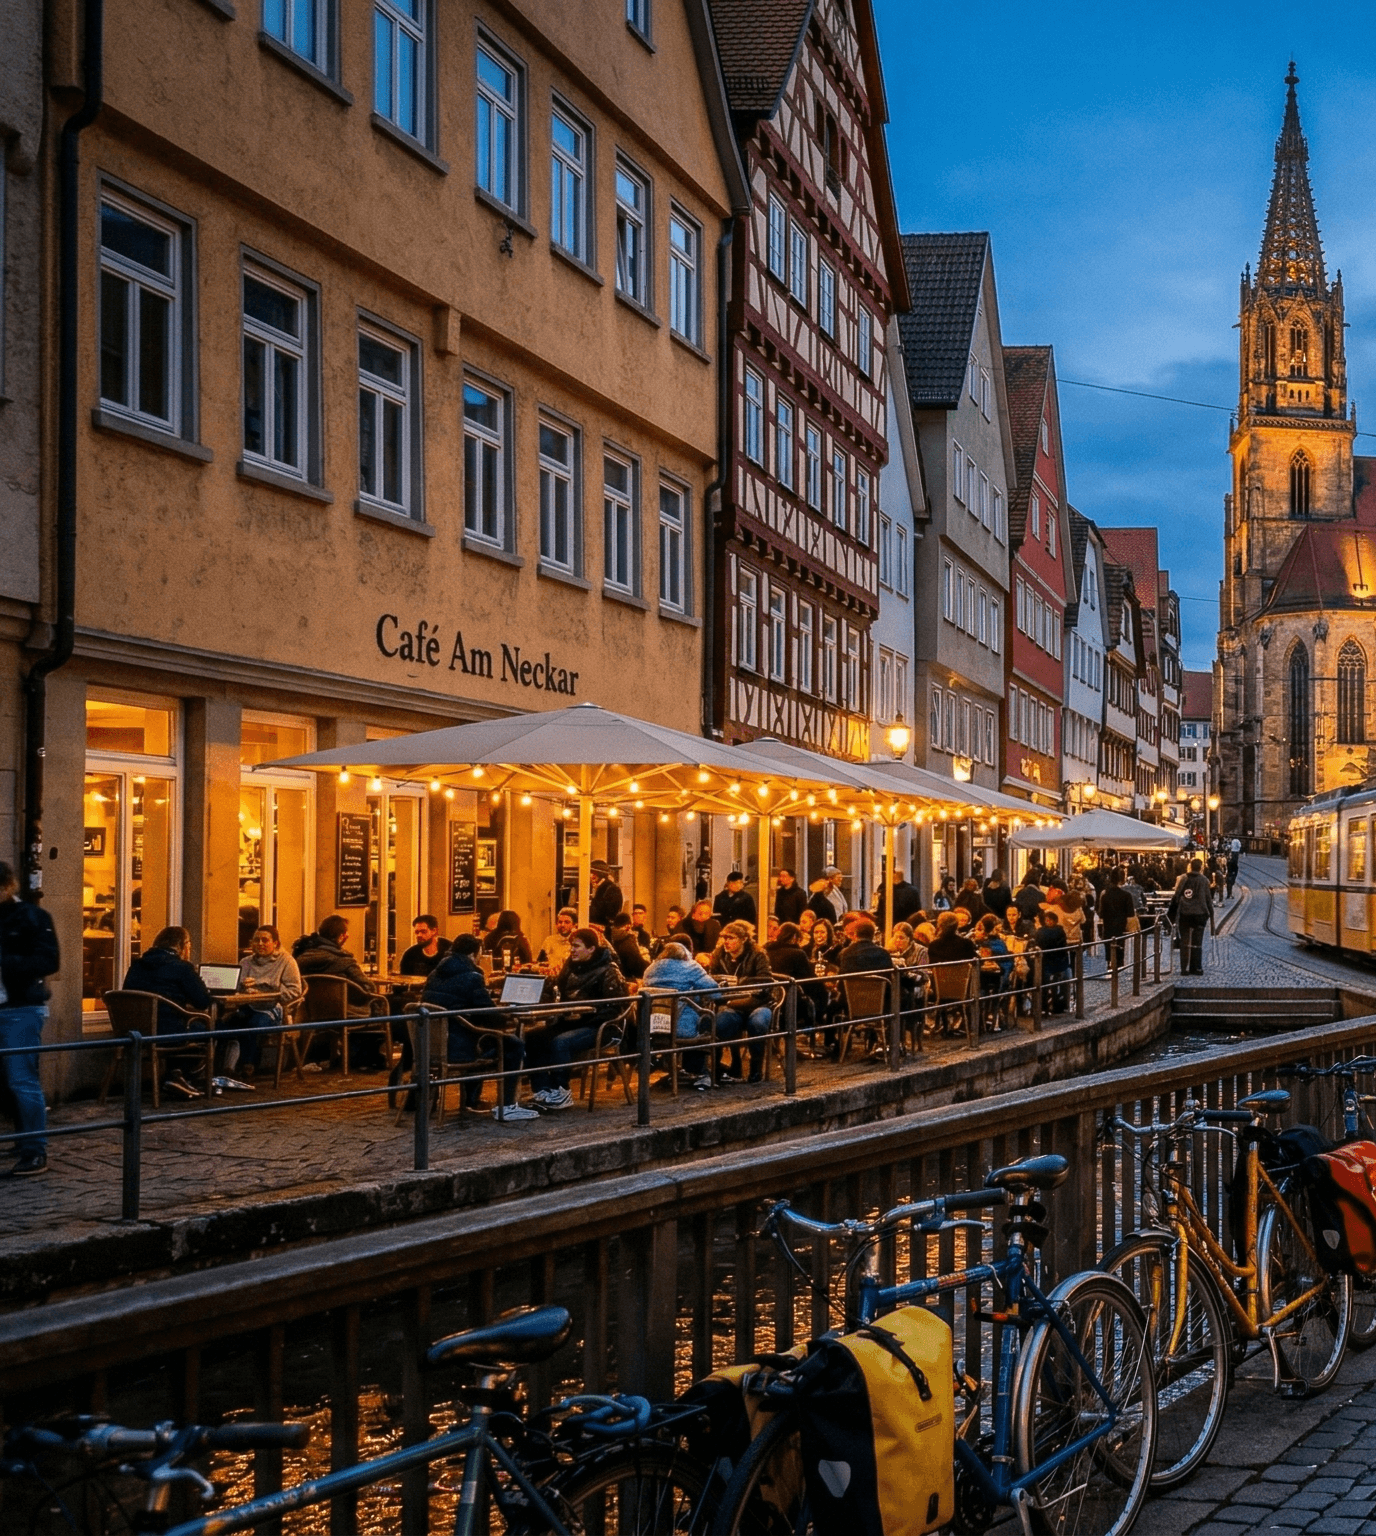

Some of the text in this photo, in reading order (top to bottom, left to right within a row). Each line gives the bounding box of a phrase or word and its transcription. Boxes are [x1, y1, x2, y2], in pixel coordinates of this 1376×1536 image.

[376, 613, 579, 696] Café Am Neckar
